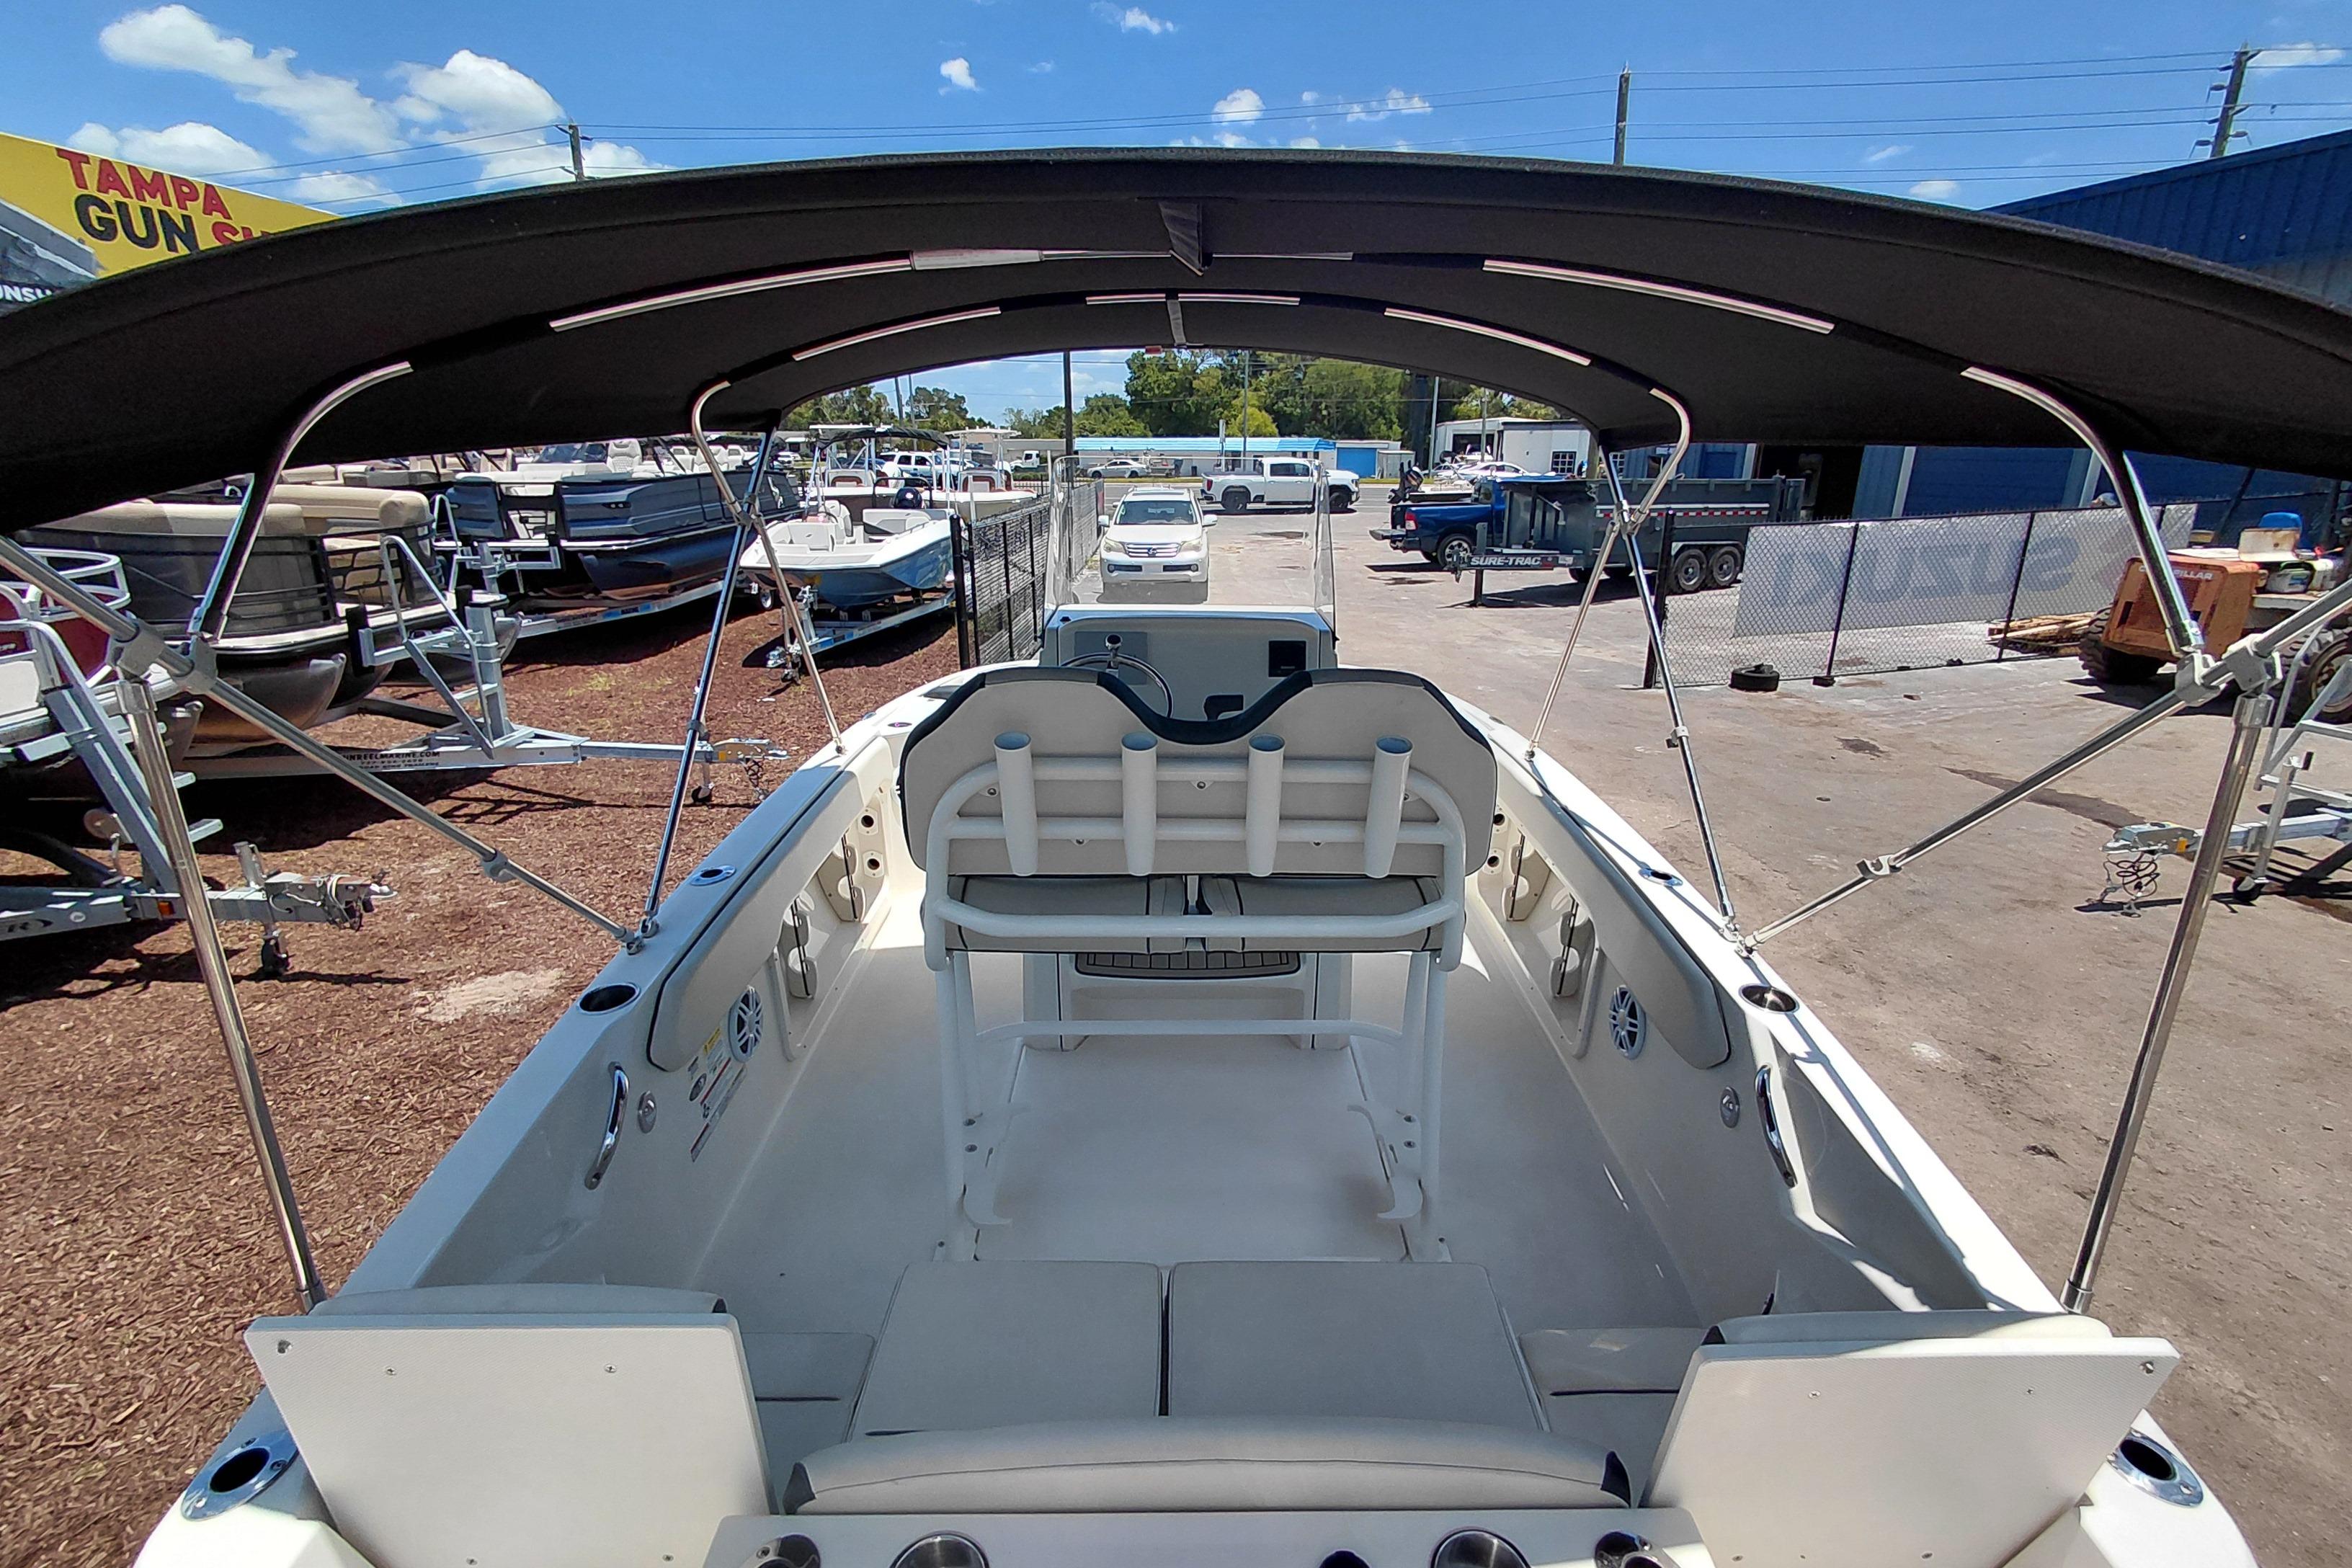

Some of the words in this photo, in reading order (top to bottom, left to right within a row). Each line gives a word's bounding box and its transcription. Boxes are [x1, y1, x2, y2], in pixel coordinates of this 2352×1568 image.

[55, 147, 233, 220] TAMPA
[74, 193, 201, 254] GUN
[1470, 556, 1541, 566] SURE-TRAC
